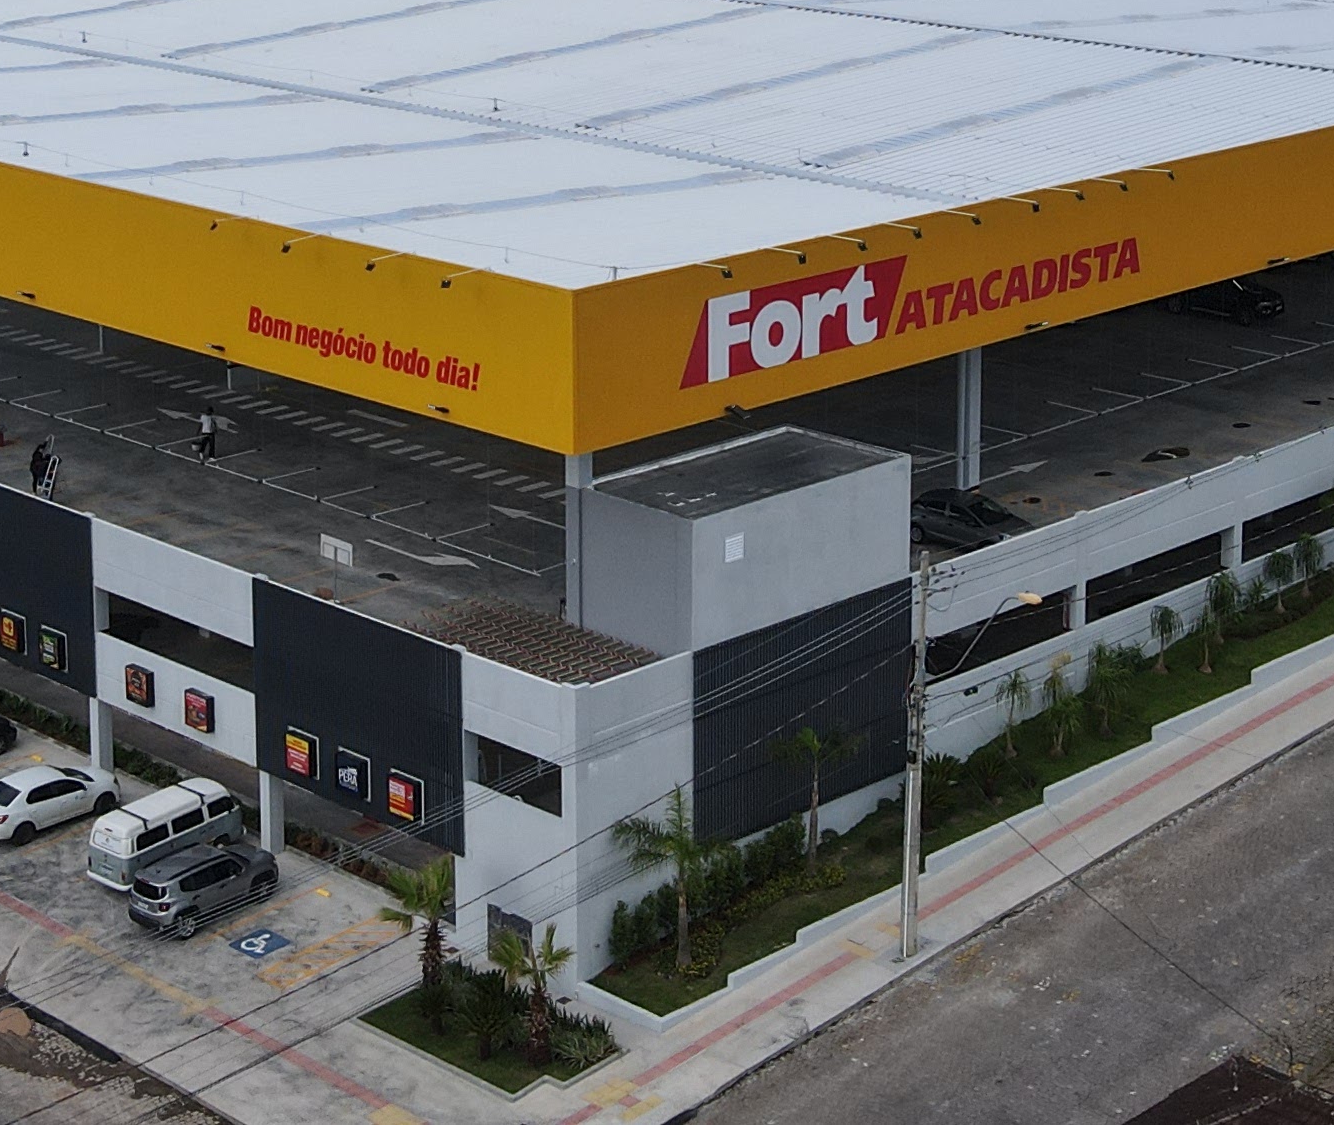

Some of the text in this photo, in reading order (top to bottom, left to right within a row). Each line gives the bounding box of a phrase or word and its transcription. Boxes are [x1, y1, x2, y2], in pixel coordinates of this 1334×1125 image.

[247, 305, 480, 392] Bom negócio todo dia!
[707, 237, 1140, 383] Fort ATACADISTA
